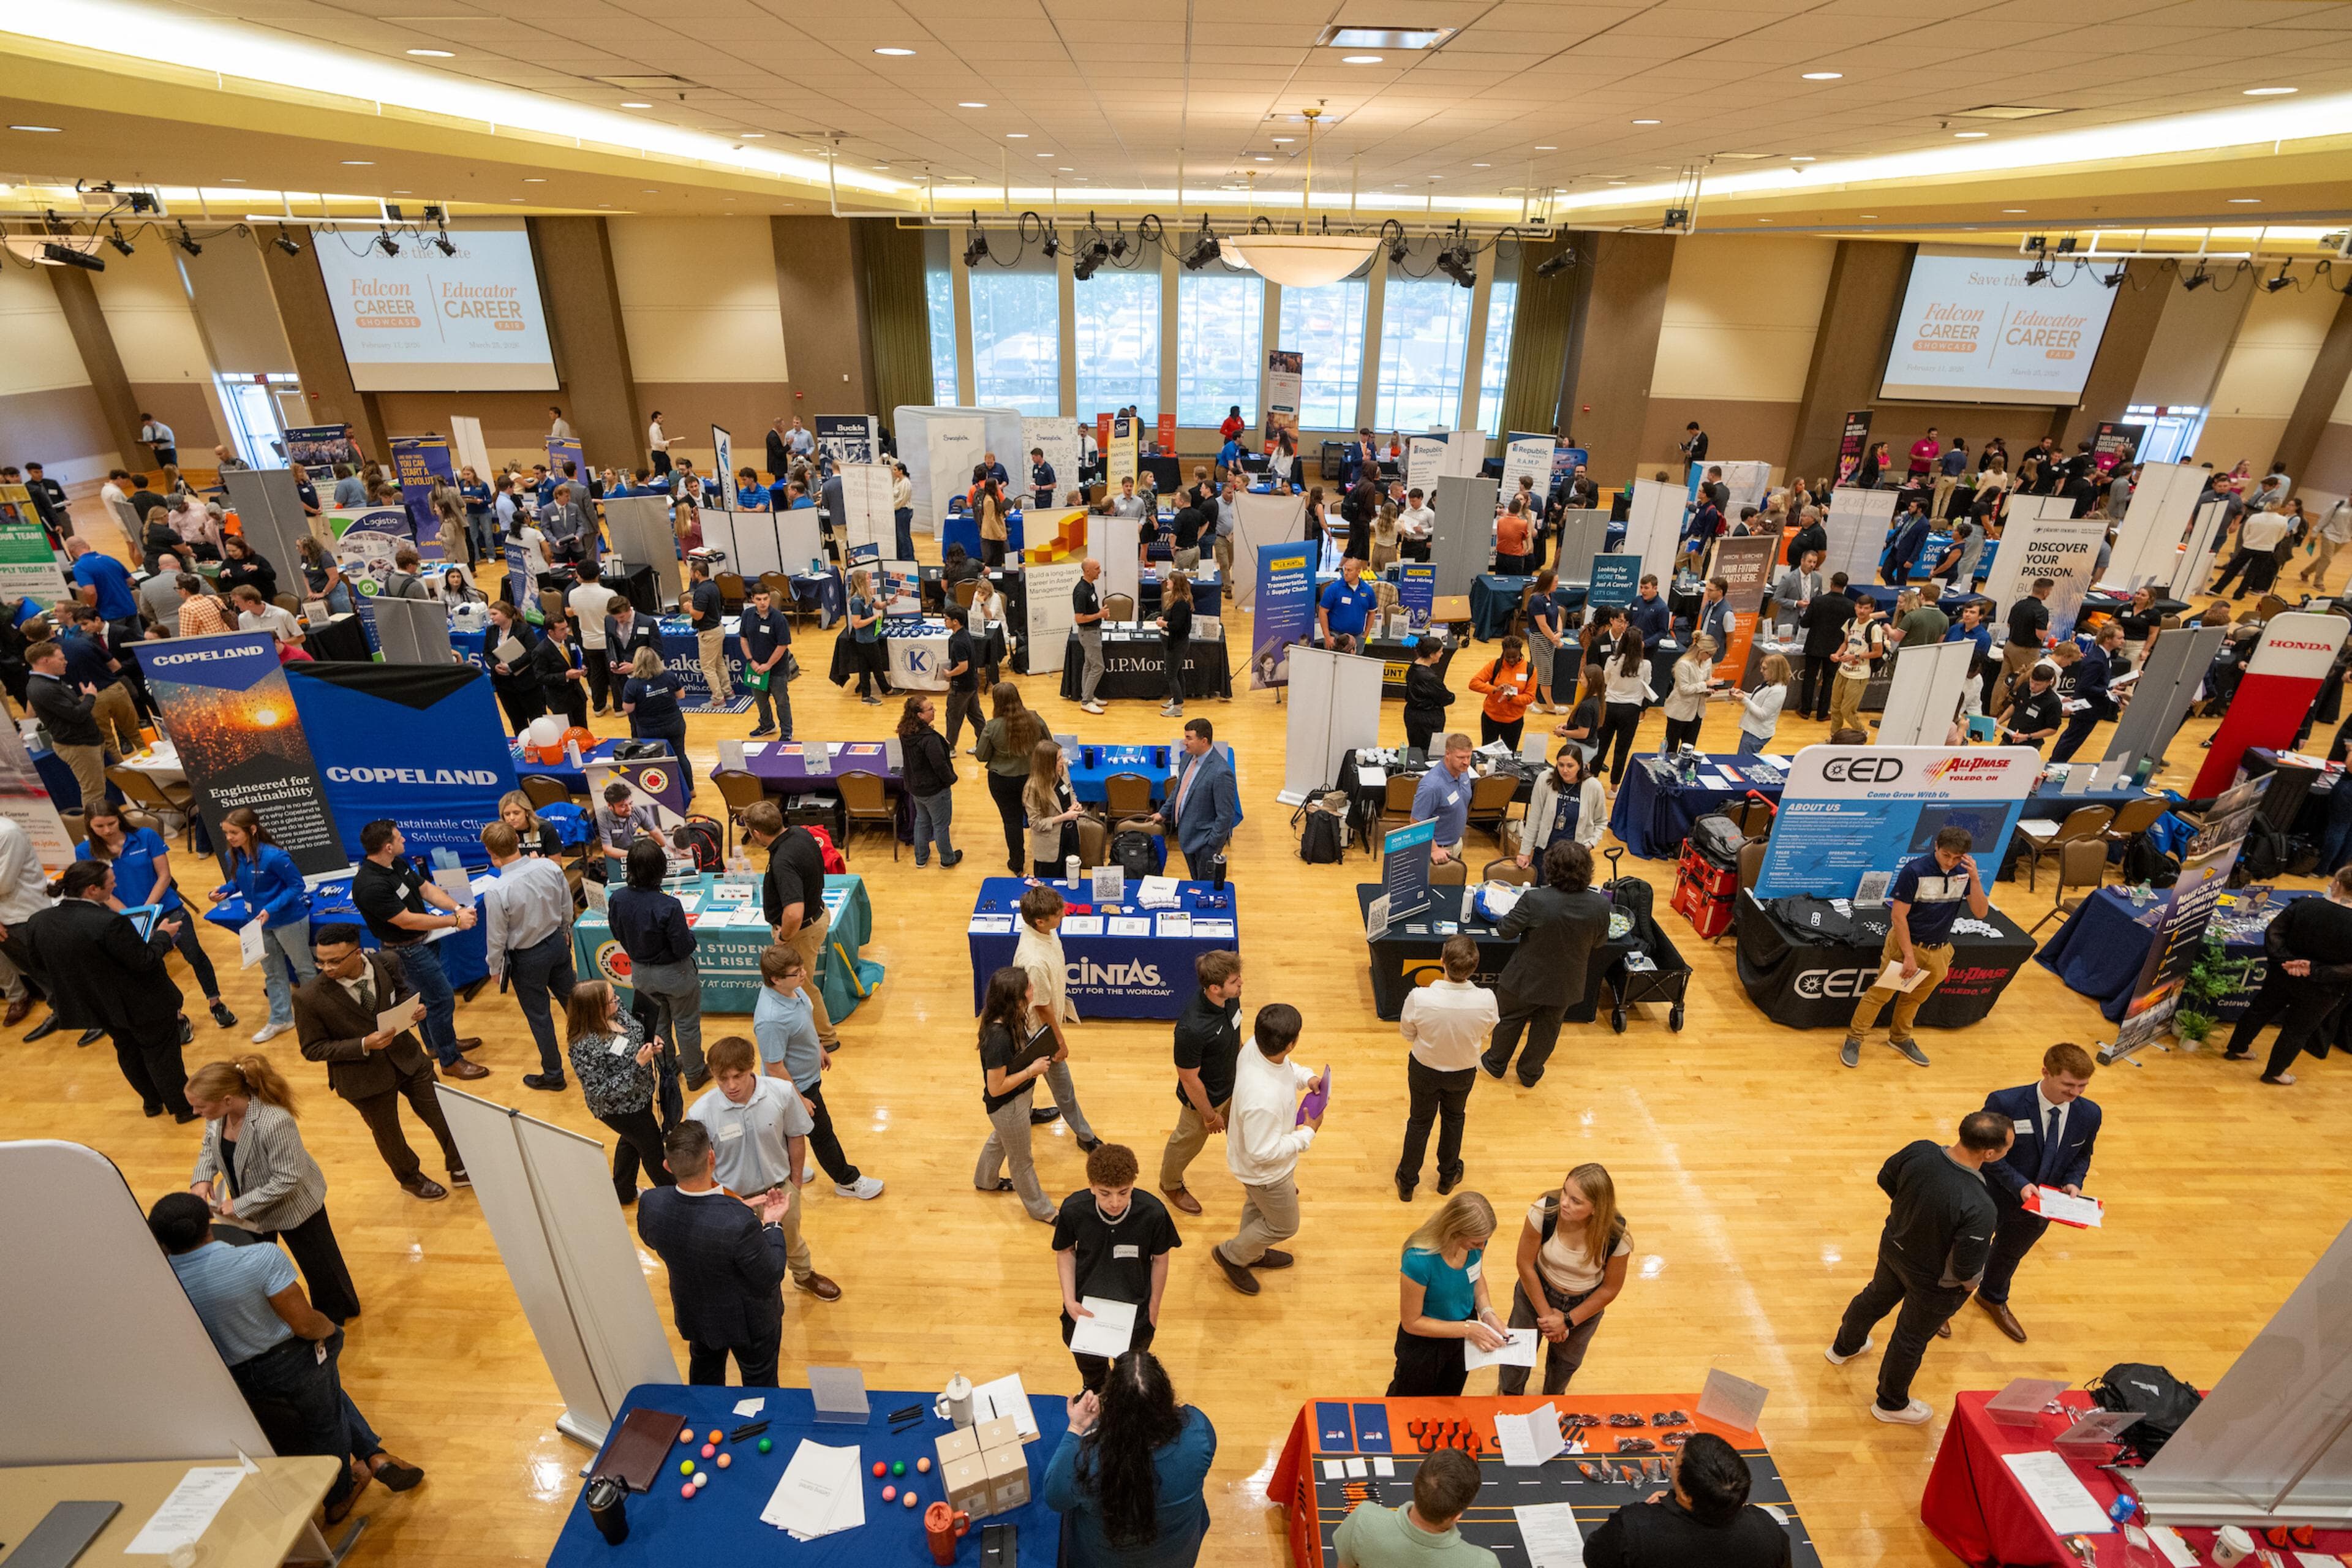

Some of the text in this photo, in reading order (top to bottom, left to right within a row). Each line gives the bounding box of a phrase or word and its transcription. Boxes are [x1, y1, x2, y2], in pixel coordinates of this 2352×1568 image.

[412, 245, 434, 258] the
[1967, 271, 2000, 285] Save
[351, 279, 412, 296] Falcon
[442, 282, 517, 298] Educator
[354, 300, 416, 315] CAREER
[444, 300, 522, 318] CAREER
[1923, 303, 1985, 322] Falcon
[361, 318, 417, 326] SHOWCASE
[2011, 310, 2087, 328] Educator
[1919, 323, 1980, 339] CAREER
[2005, 328, 2081, 348] CAREER
[1917, 342, 1972, 351] SHOWCASE
[837, 423, 865, 432] Buckle
[1518, 446, 1548, 456] Republic
[402, 468, 423, 477] START
[404, 477, 435, 486] REVOLUT
[2029, 541, 2088, 554] DISCOVER
[2026, 554, 2059, 565] YOUR
[1721, 563, 1761, 573] YOUR FUTURE
[2021, 567, 2074, 577] PASSION.
[1271, 573, 1305, 582] Reinventing
[1720, 573, 1758, 583] TARTS HERE.
[1267, 579, 1308, 589] Transportation
[1029, 586, 1069, 594] Management
[2268, 639, 2333, 651] HONDA
[153, 645, 264, 666] COPELAND
[910, 651, 927, 671] K
[1822, 757, 1904, 783] CED
[1945, 757, 2011, 774] ALL-PHASE
[325, 766, 498, 786] COPELAND
[209, 775, 311, 799] Engineered for
[221, 786, 314, 809] Sustainability
[1787, 803, 1825, 812] ABOUT
[270, 812, 284, 820] why
[284, 807, 315, 817] Copeland
[284, 815, 305, 824] global
[303, 819, 326, 829] geared
[293, 826, 328, 837] sustainable
[297, 832, 330, 843] generation
[411, 832, 470, 843] Solutions
[313, 840, 333, 848] come.
[721, 957, 758, 966] RISE.
